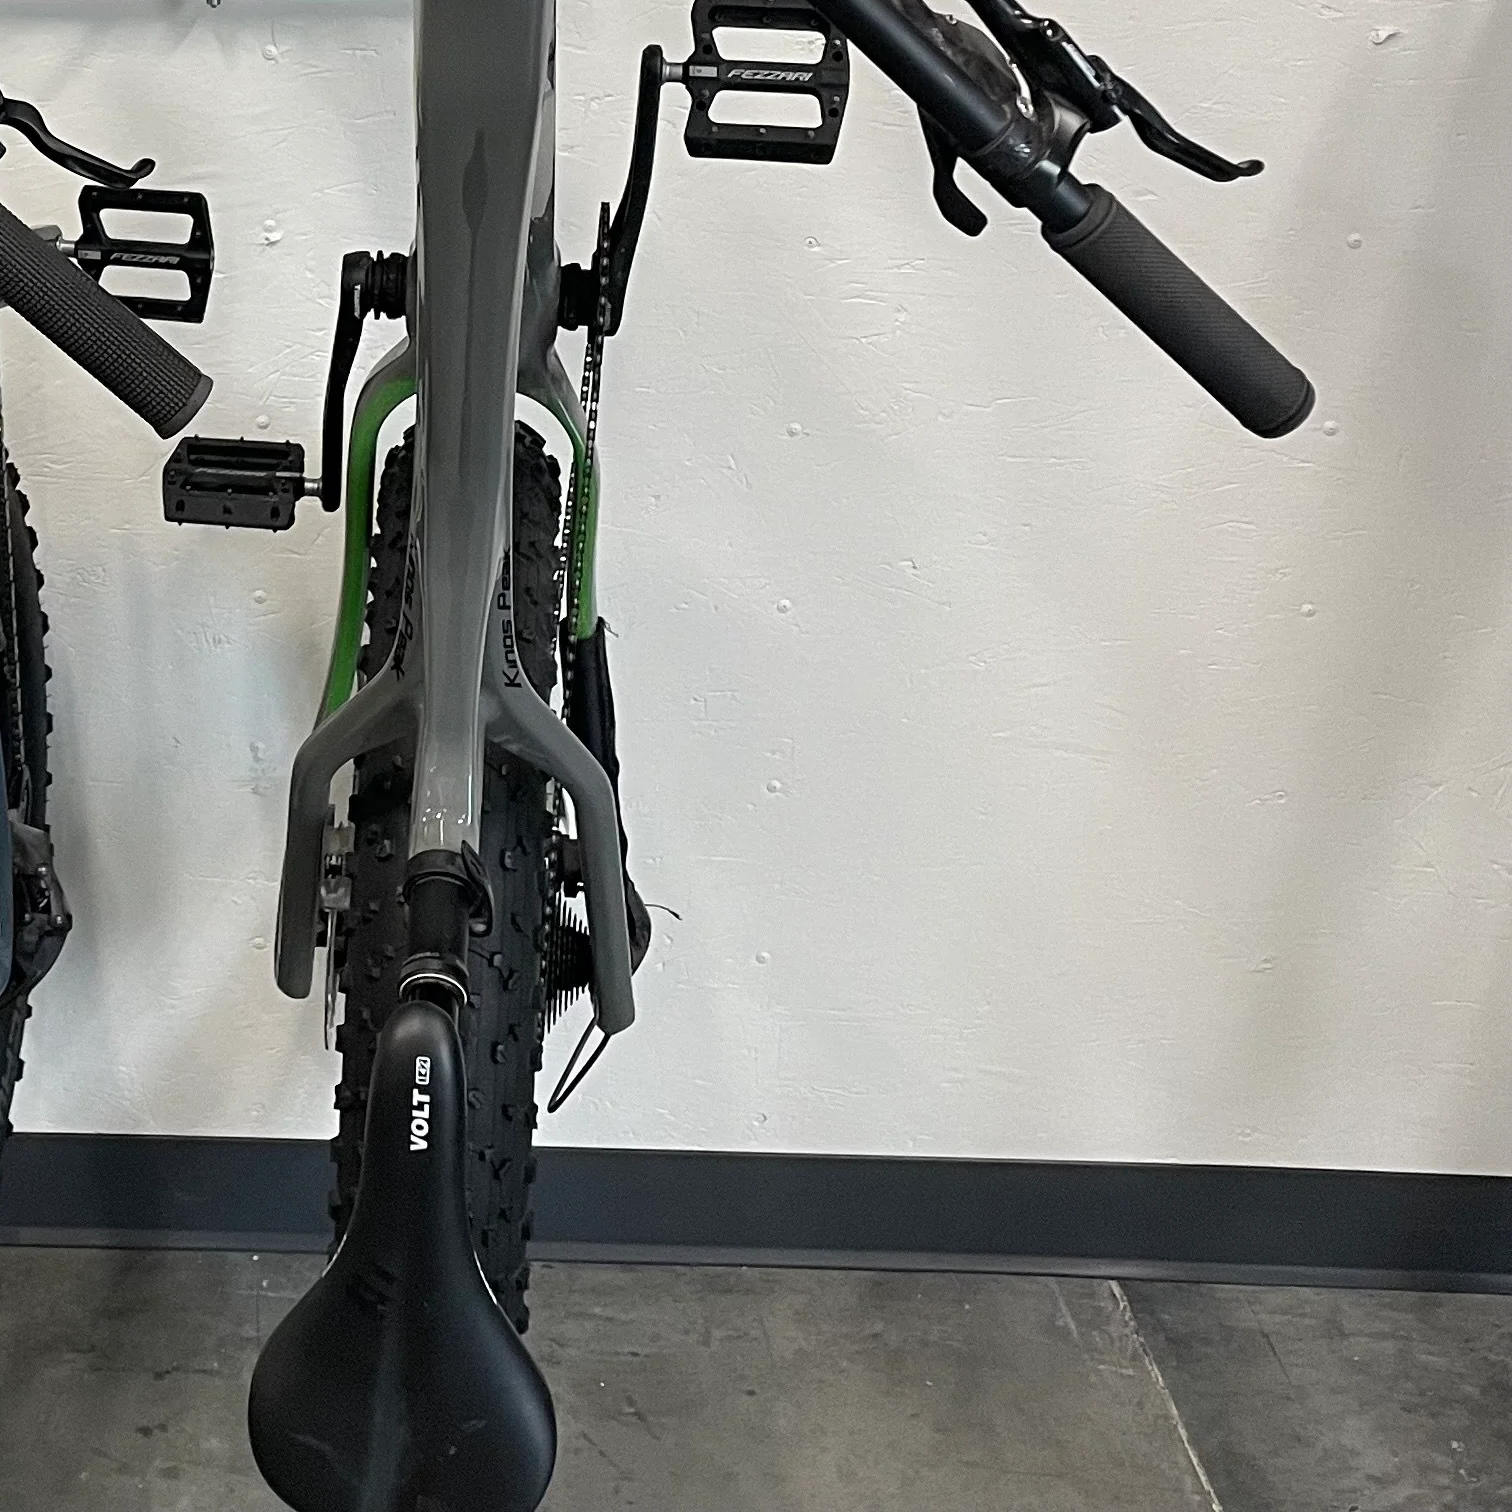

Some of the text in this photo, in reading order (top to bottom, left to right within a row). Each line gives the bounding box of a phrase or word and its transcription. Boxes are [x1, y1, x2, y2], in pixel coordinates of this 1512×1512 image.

[728, 69, 813, 82] FEZZARI
[109, 252, 180, 265] FEZZARI
[497, 547, 512, 611] Peak
[410, 1088, 430, 1151] VOLT
